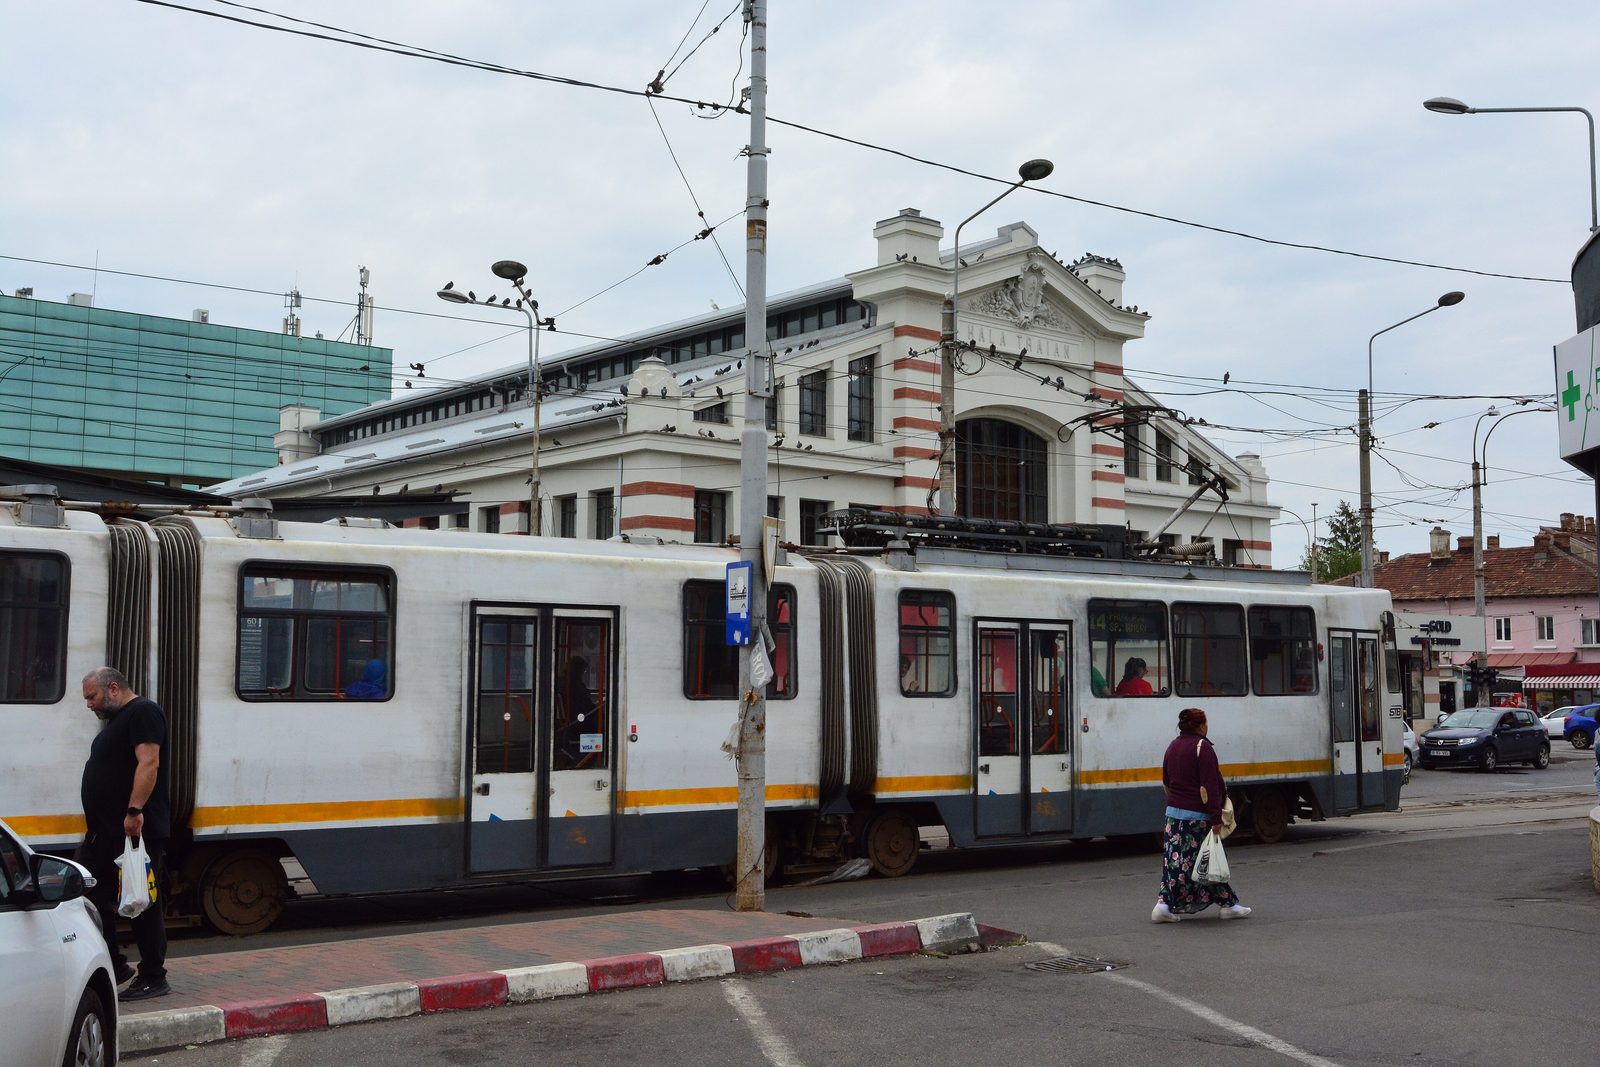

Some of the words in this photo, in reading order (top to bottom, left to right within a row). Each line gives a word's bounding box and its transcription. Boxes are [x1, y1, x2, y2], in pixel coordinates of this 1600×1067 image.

[967, 324, 1006, 347] HALA
[1016, 334, 1070, 360] TRAIAN
[246, 617, 257, 625] 60
[1429, 620, 1452, 633] GOLD
[751, 639, 769, 688] EROX
[1389, 707, 1402, 717] STB
